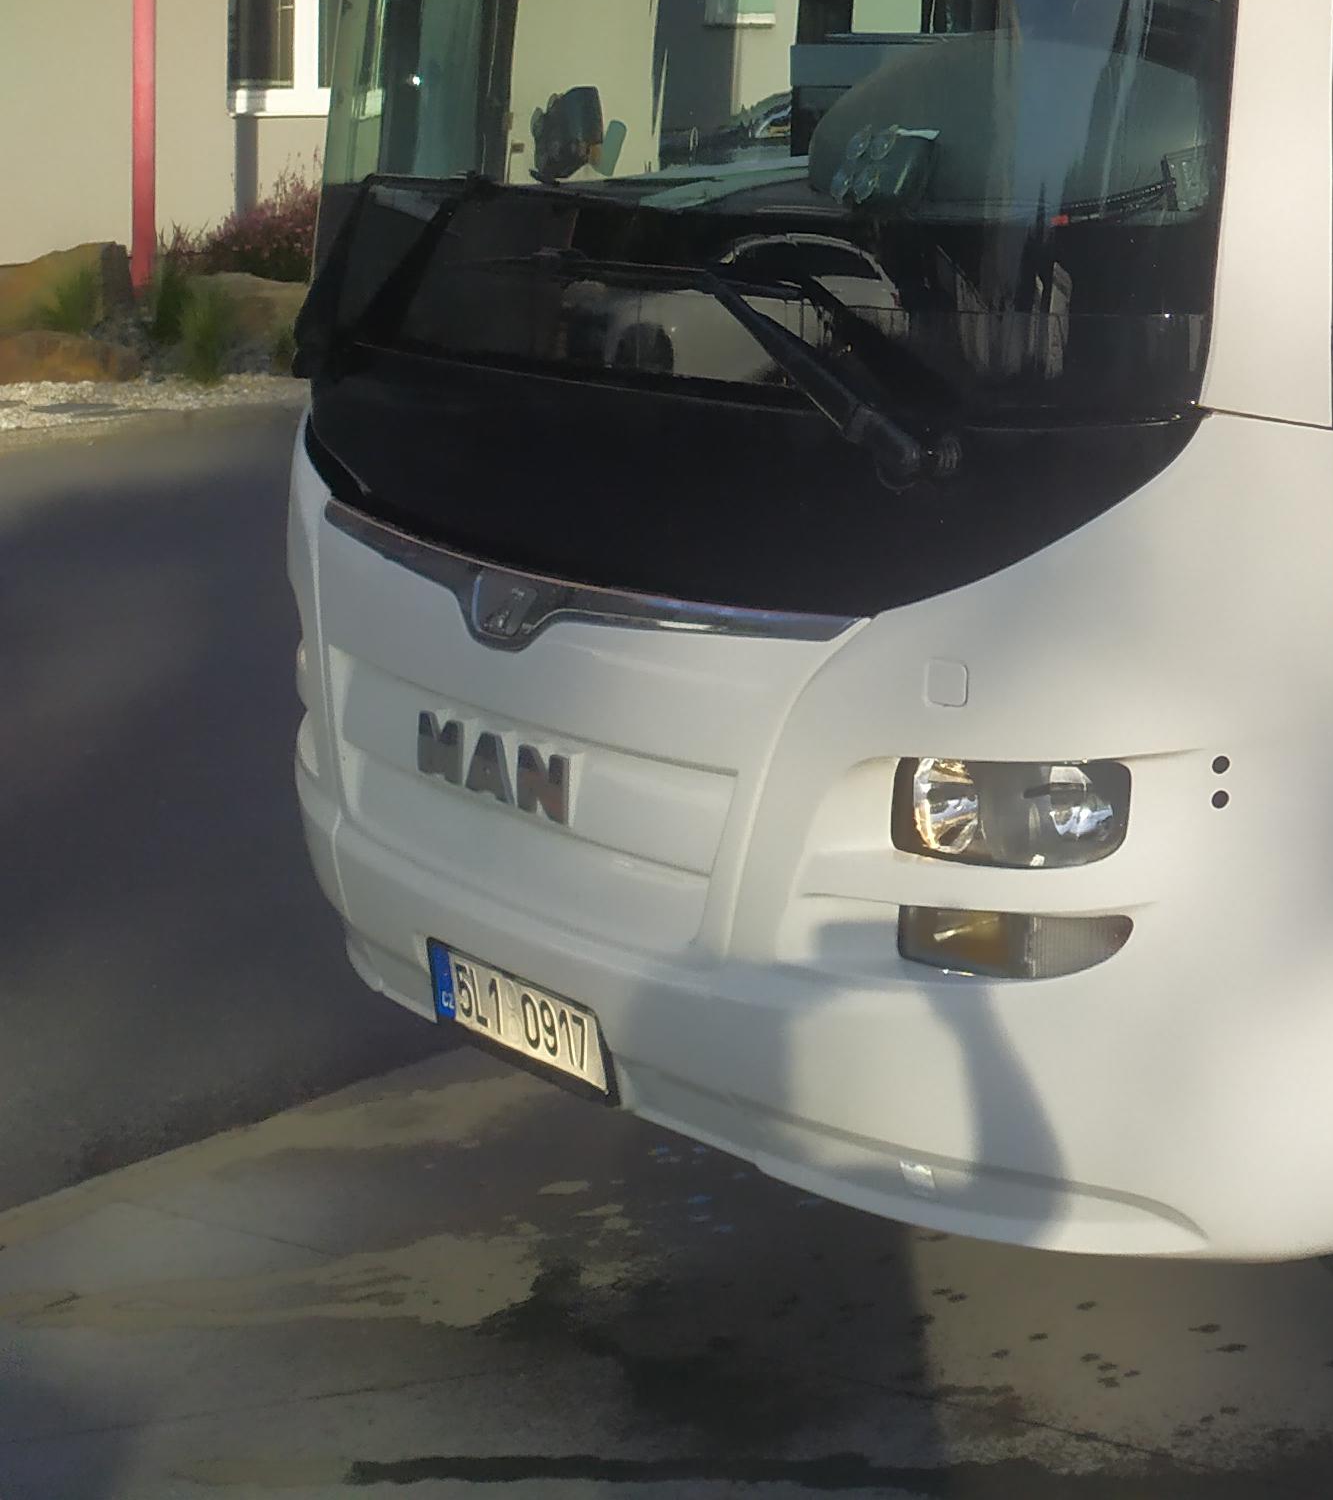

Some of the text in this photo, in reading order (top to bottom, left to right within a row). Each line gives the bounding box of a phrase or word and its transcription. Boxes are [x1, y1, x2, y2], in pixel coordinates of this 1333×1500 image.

[417, 709, 571, 827] MAN
[442, 991, 455, 1010] CZ
[455, 962, 588, 1072] 5L1 0917
